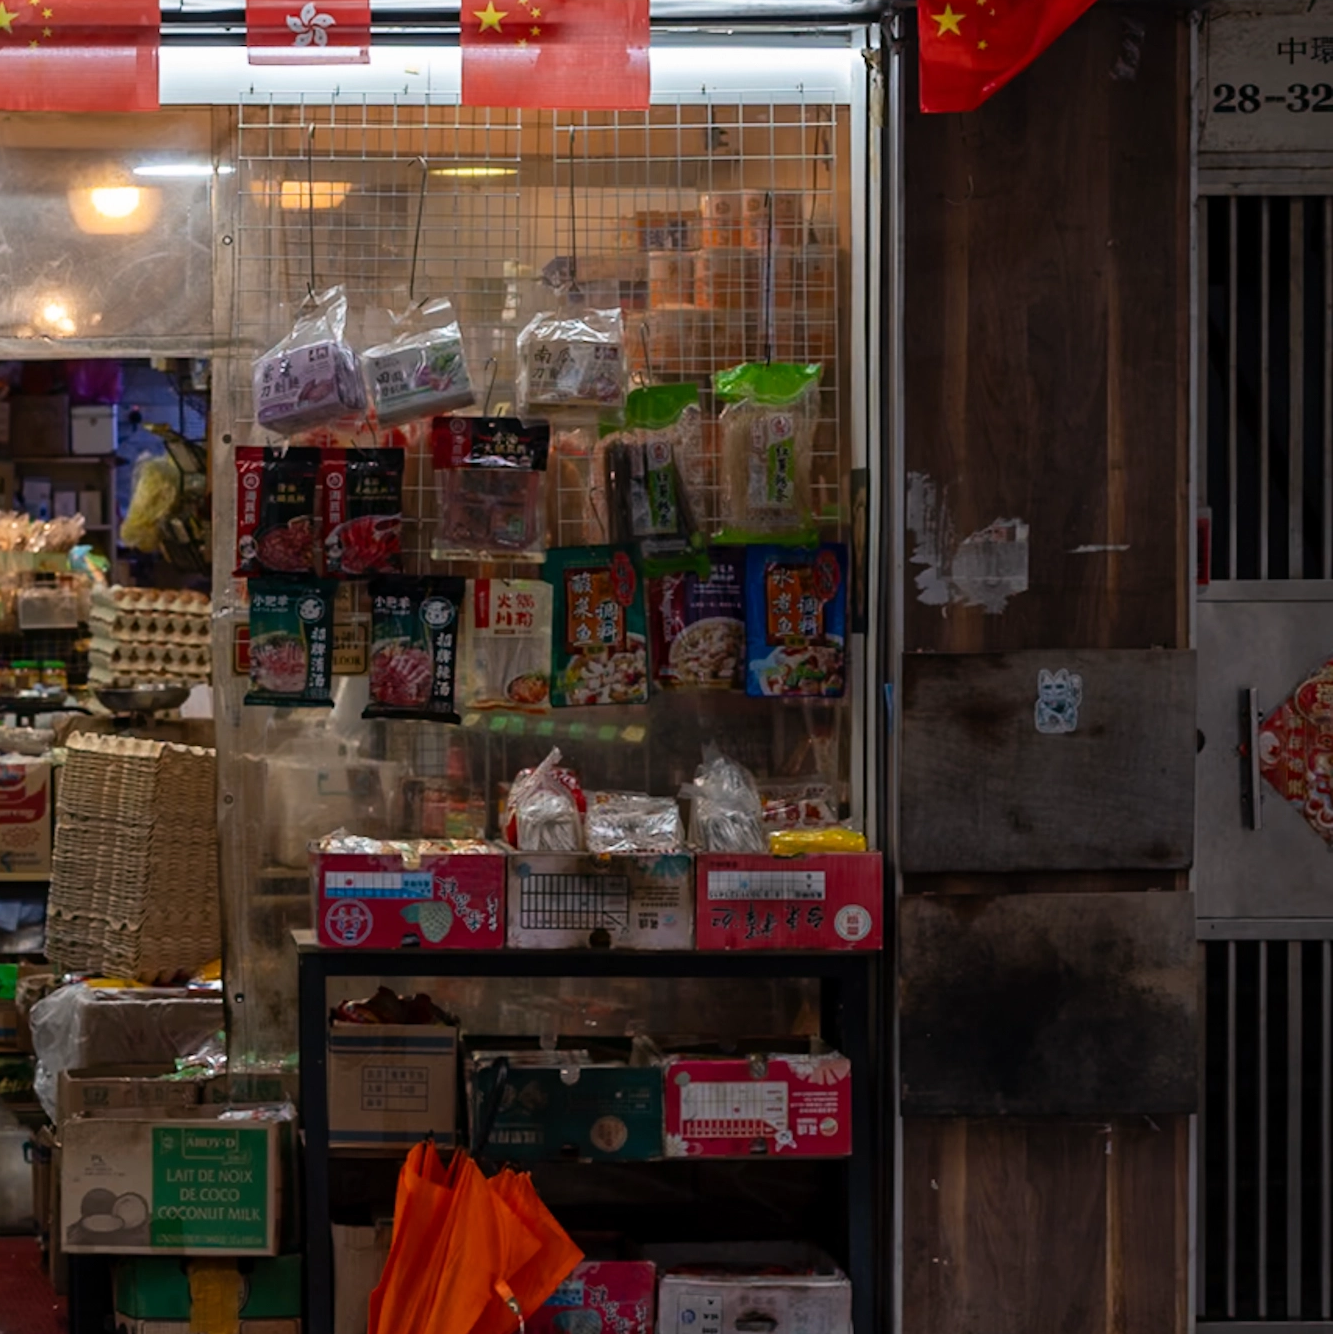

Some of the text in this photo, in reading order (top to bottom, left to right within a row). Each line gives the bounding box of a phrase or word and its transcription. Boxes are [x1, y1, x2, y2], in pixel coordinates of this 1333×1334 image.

[1277, 36, 1333, 65] 中環
[166, 1169, 254, 1184] LAIT DE NOIX
[179, 1188, 241, 1203] DE COCO
[157, 1205, 262, 1222] COCONUT MILK
